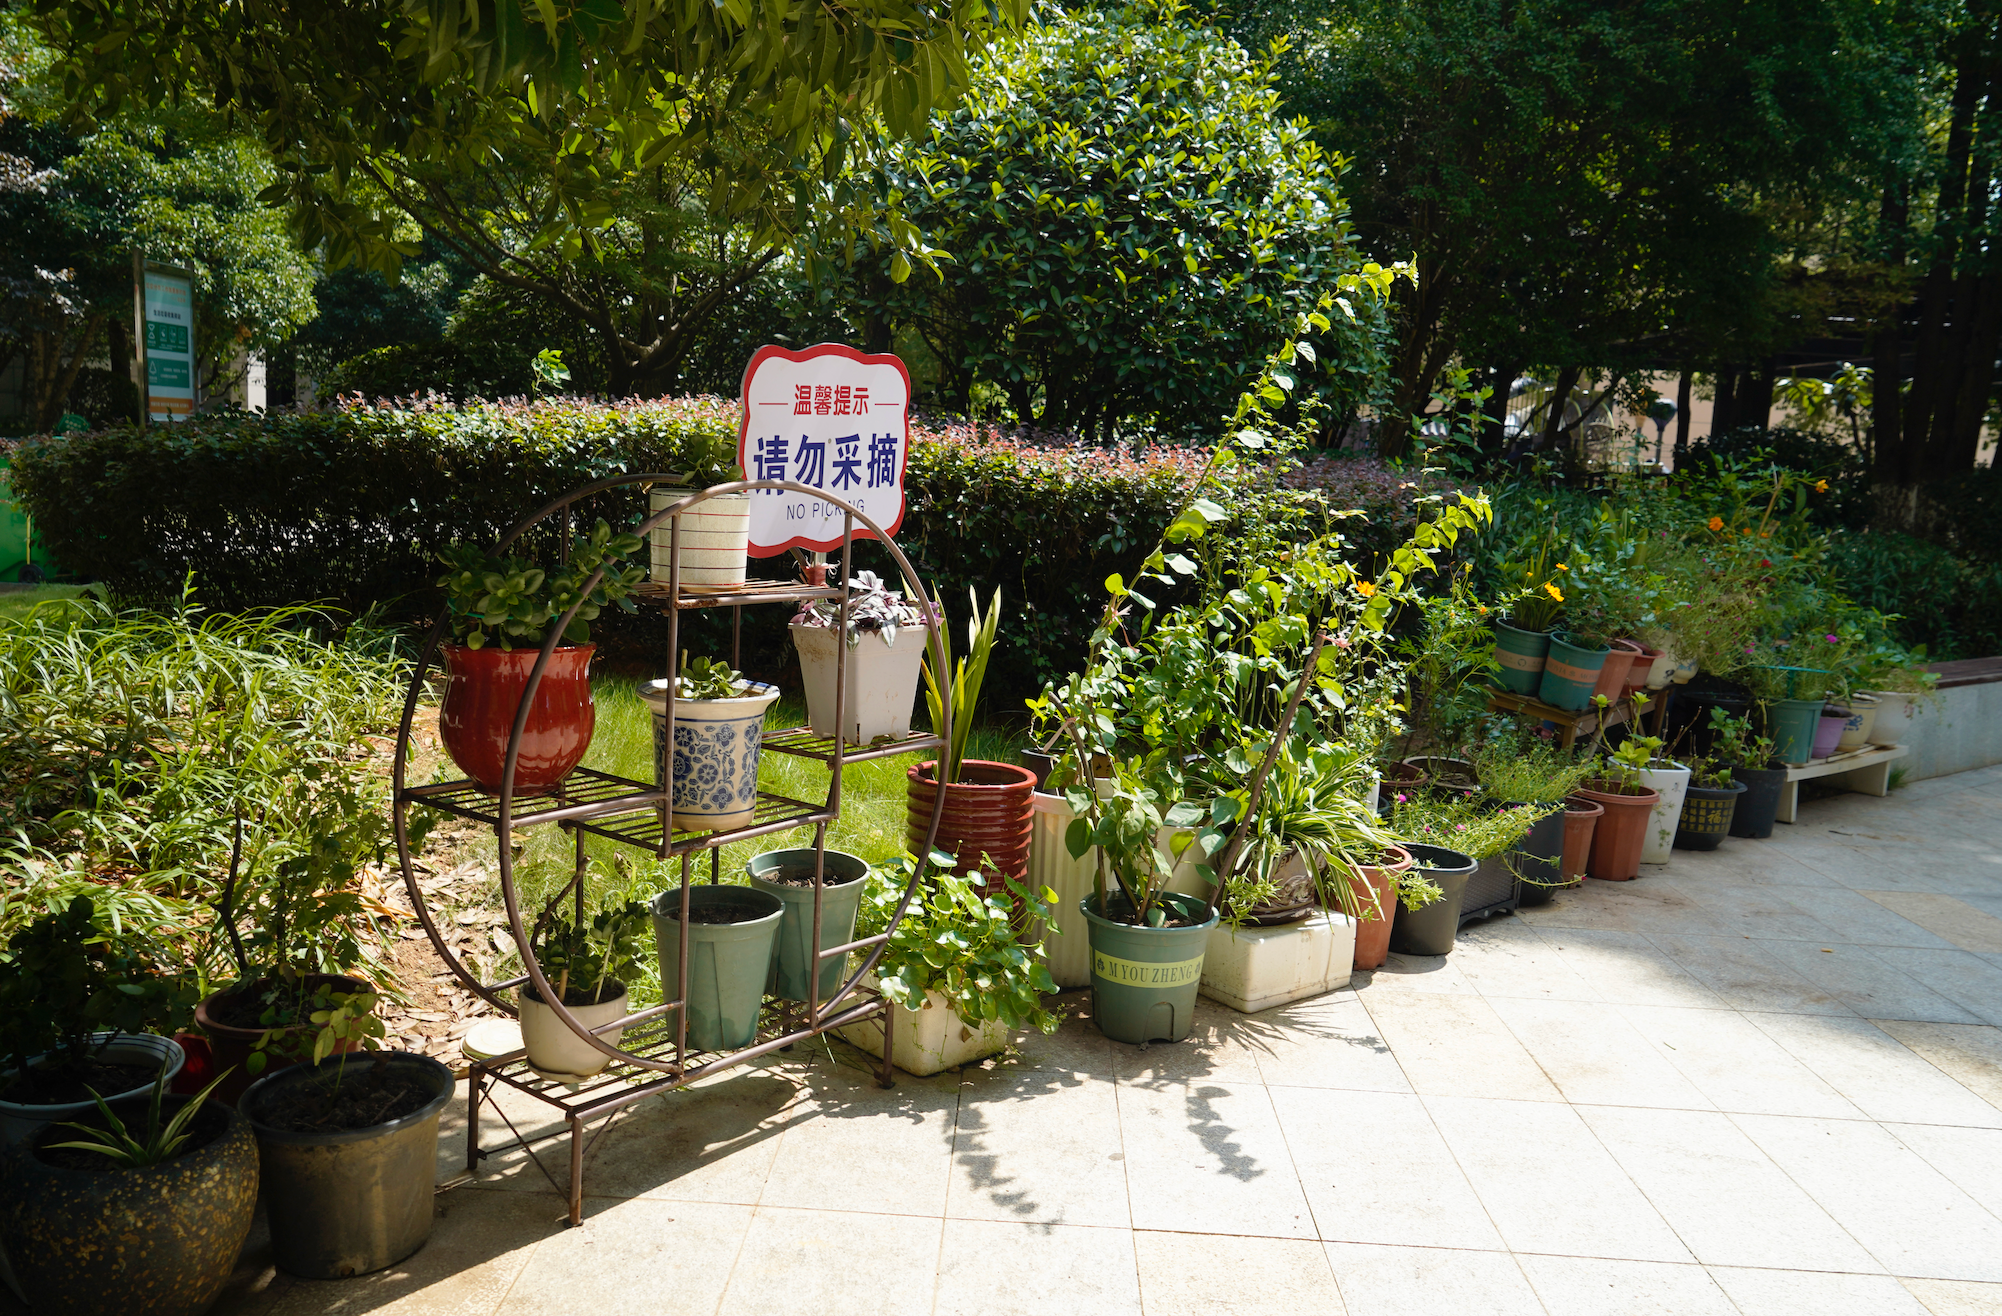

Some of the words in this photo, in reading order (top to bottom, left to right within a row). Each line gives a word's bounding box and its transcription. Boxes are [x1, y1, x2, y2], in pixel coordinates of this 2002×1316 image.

[793, 384, 870, 416] 温馨提示
[753, 433, 898, 496] 请勿采摘
[786, 503, 806, 521] NO
[812, 499, 865, 519] PICKG
[1707, 809, 1722, 824] 福
